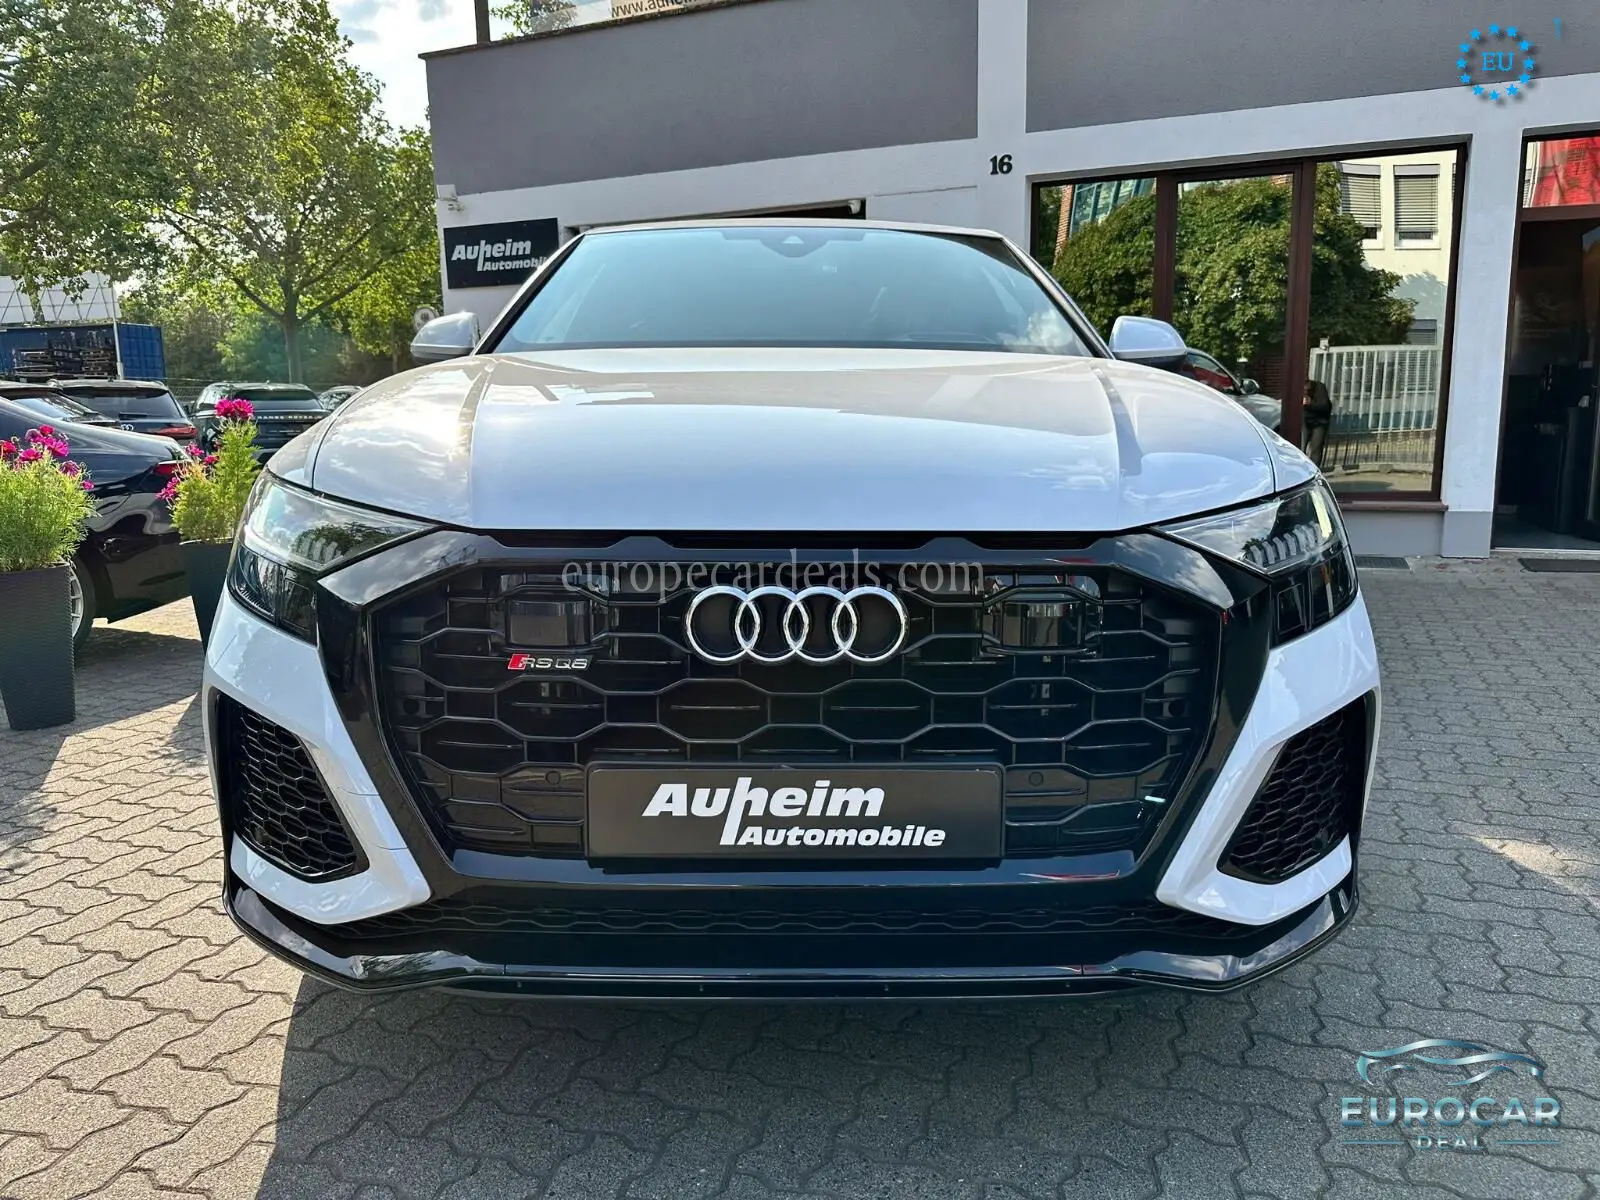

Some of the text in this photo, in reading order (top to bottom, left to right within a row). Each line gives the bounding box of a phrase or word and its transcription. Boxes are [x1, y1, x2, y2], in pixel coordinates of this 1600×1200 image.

[608, 0, 697, 18] www.au
[989, 154, 1013, 175] 16
[451, 239, 532, 272] Auheim
[483, 256, 549, 271] Automobi
[642, 776, 885, 846] Auheim
[737, 825, 946, 847] Automobile
